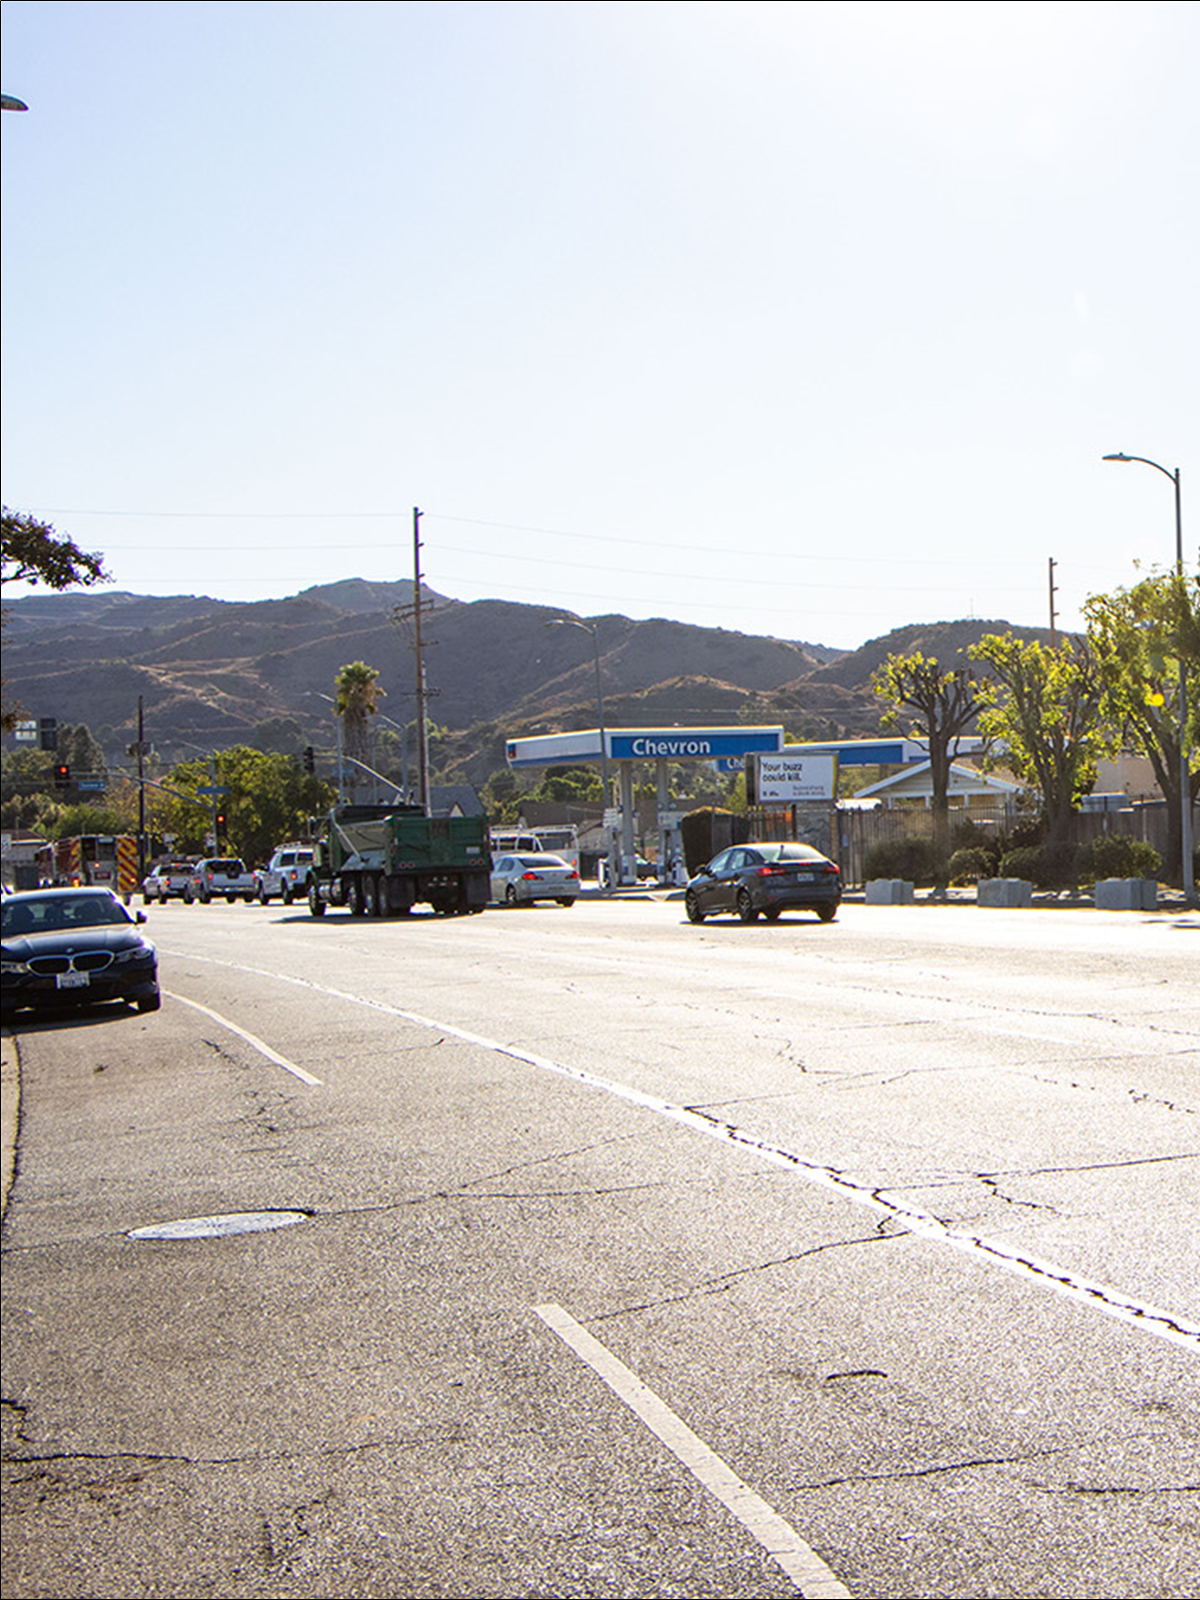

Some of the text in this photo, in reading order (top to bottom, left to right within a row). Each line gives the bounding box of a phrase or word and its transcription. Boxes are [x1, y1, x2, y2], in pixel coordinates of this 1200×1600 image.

[632, 738, 711, 756] Chevron
[762, 762, 802, 771] Your buzz
[762, 772, 786, 782] could
